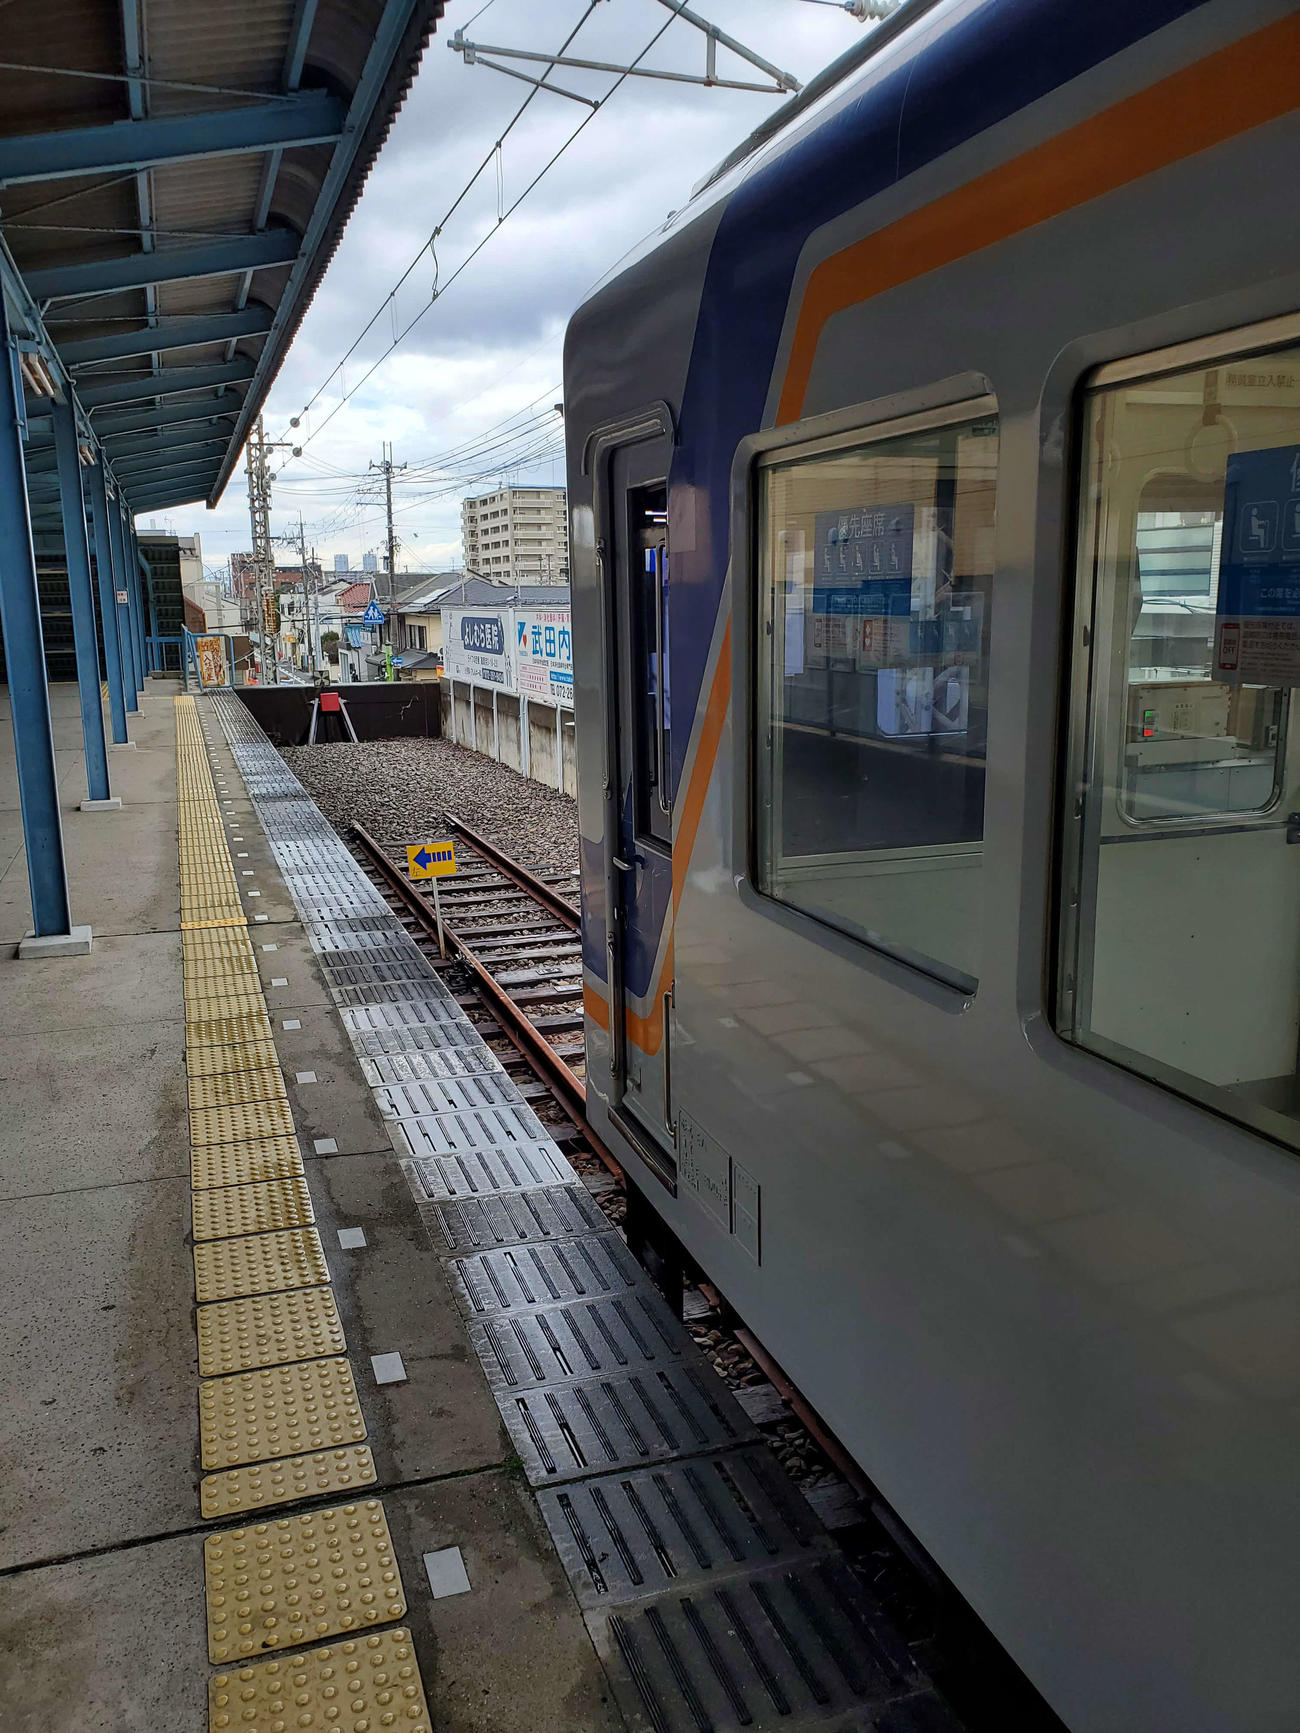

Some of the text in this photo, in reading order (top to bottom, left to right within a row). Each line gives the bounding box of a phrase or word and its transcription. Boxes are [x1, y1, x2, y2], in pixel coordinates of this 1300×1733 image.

[838, 513, 886, 539] 優先座席
[464, 622, 499, 651] よしむら医院
[531, 624, 571, 661] 武田内
